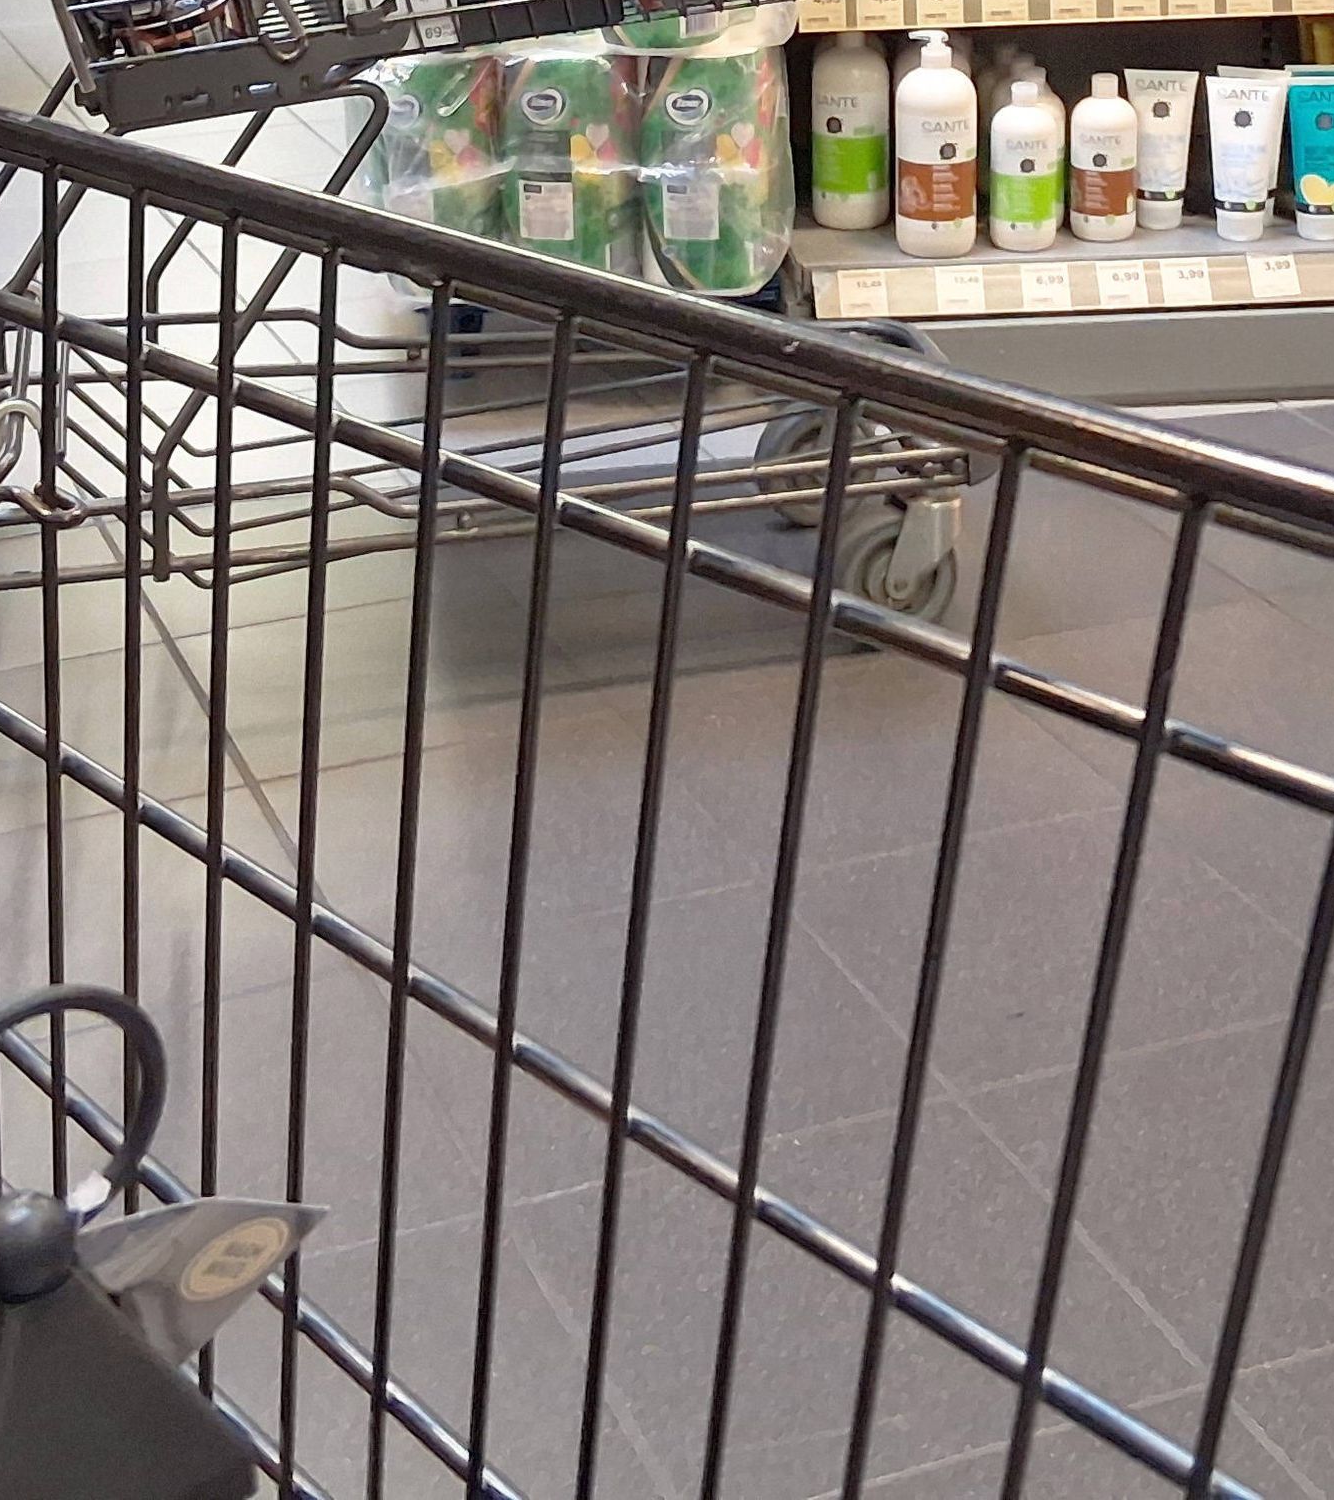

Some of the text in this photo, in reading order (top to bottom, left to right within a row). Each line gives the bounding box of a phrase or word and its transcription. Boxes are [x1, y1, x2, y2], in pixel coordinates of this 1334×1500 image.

[1135, 78, 1188, 92] SANTE
[1217, 88, 1269, 100] SANTE
[921, 120, 970, 134] SANTE
[1006, 139, 1048, 150] SANTE
[1079, 134, 1121, 145] SANTE
